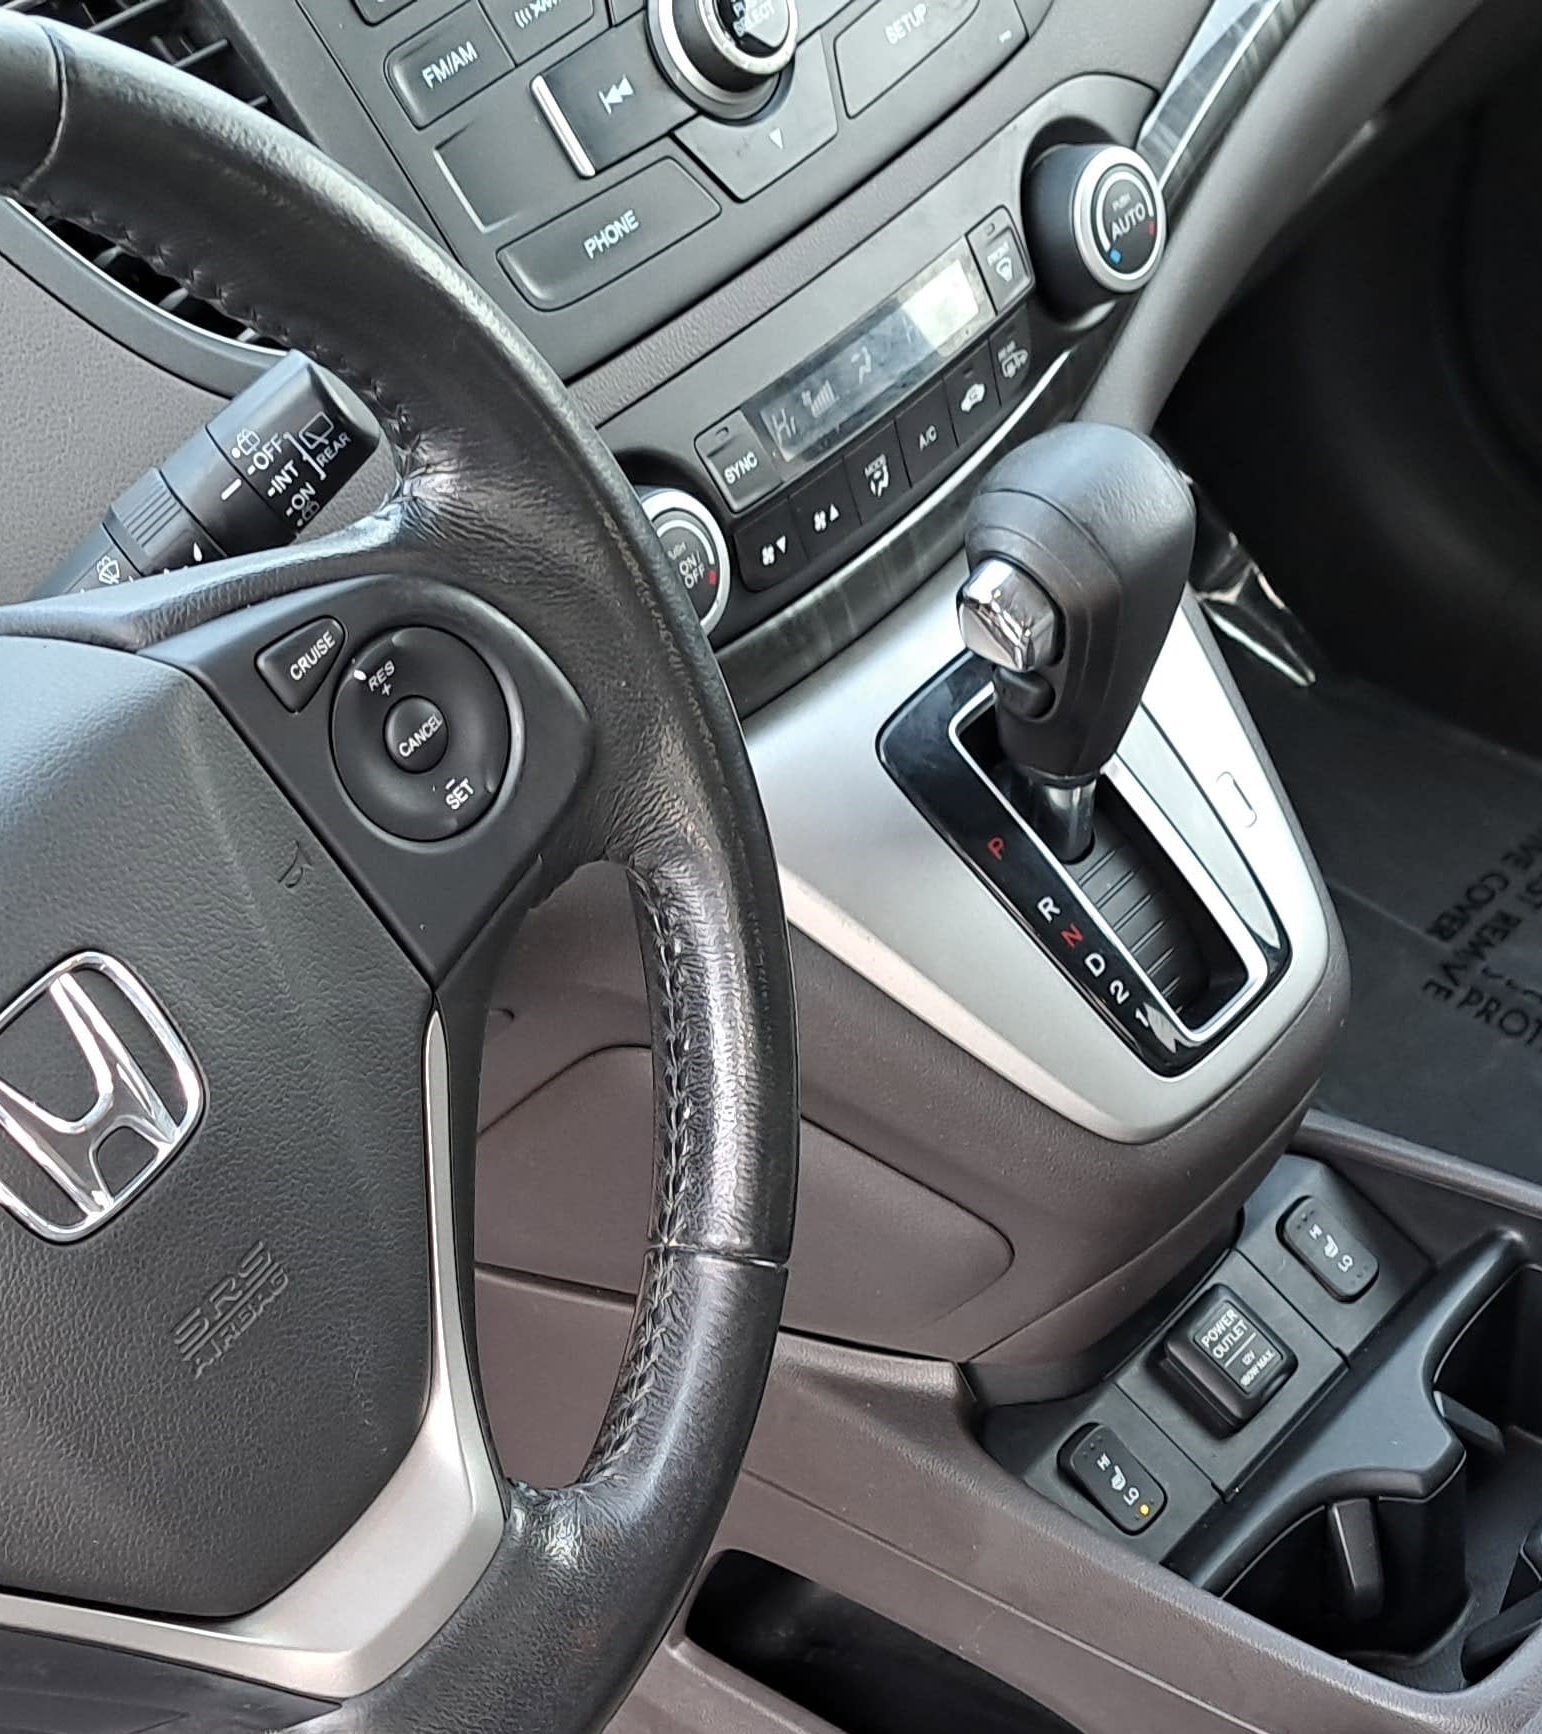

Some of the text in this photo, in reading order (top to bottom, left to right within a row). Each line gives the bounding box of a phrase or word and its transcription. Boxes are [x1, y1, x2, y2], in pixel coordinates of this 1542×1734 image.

[885, 3, 928, 44] SETUP
[421, 40, 479, 89] FM/AM
[583, 209, 640, 260] PHONE
[1112, 203, 1146, 242] AUTO
[253, 433, 283, 470] OFF
[316, 432, 351, 467] REAR
[919, 425, 938, 451] A/C
[271, 459, 299, 494] INT
[723, 451, 758, 485] SYNC
[291, 482, 316, 510] ON
[685, 562, 705, 589] OFF
[289, 630, 336, 682] CRUISE
[368, 661, 396, 692] RES
[398, 714, 444, 758] CANCEL
[445, 778, 475, 810] SET
[987, 836, 1005, 861] P
[1037, 896, 1061, 922] R
[1061, 923, 1084, 949] N
[1084, 952, 1106, 977] D
[1422, 910, 1523, 1001] REMVE
[1109, 979, 1130, 1006] 2
[1135, 1010, 1150, 1028] 1
[174, 1241, 272, 1353] SRS
[195, 1267, 289, 1380] AIRBAG
[1201, 1309, 1238, 1348] POWER
[1213, 1320, 1247, 1359] OUTLET
[1097, 1452, 1111, 1471] HI
